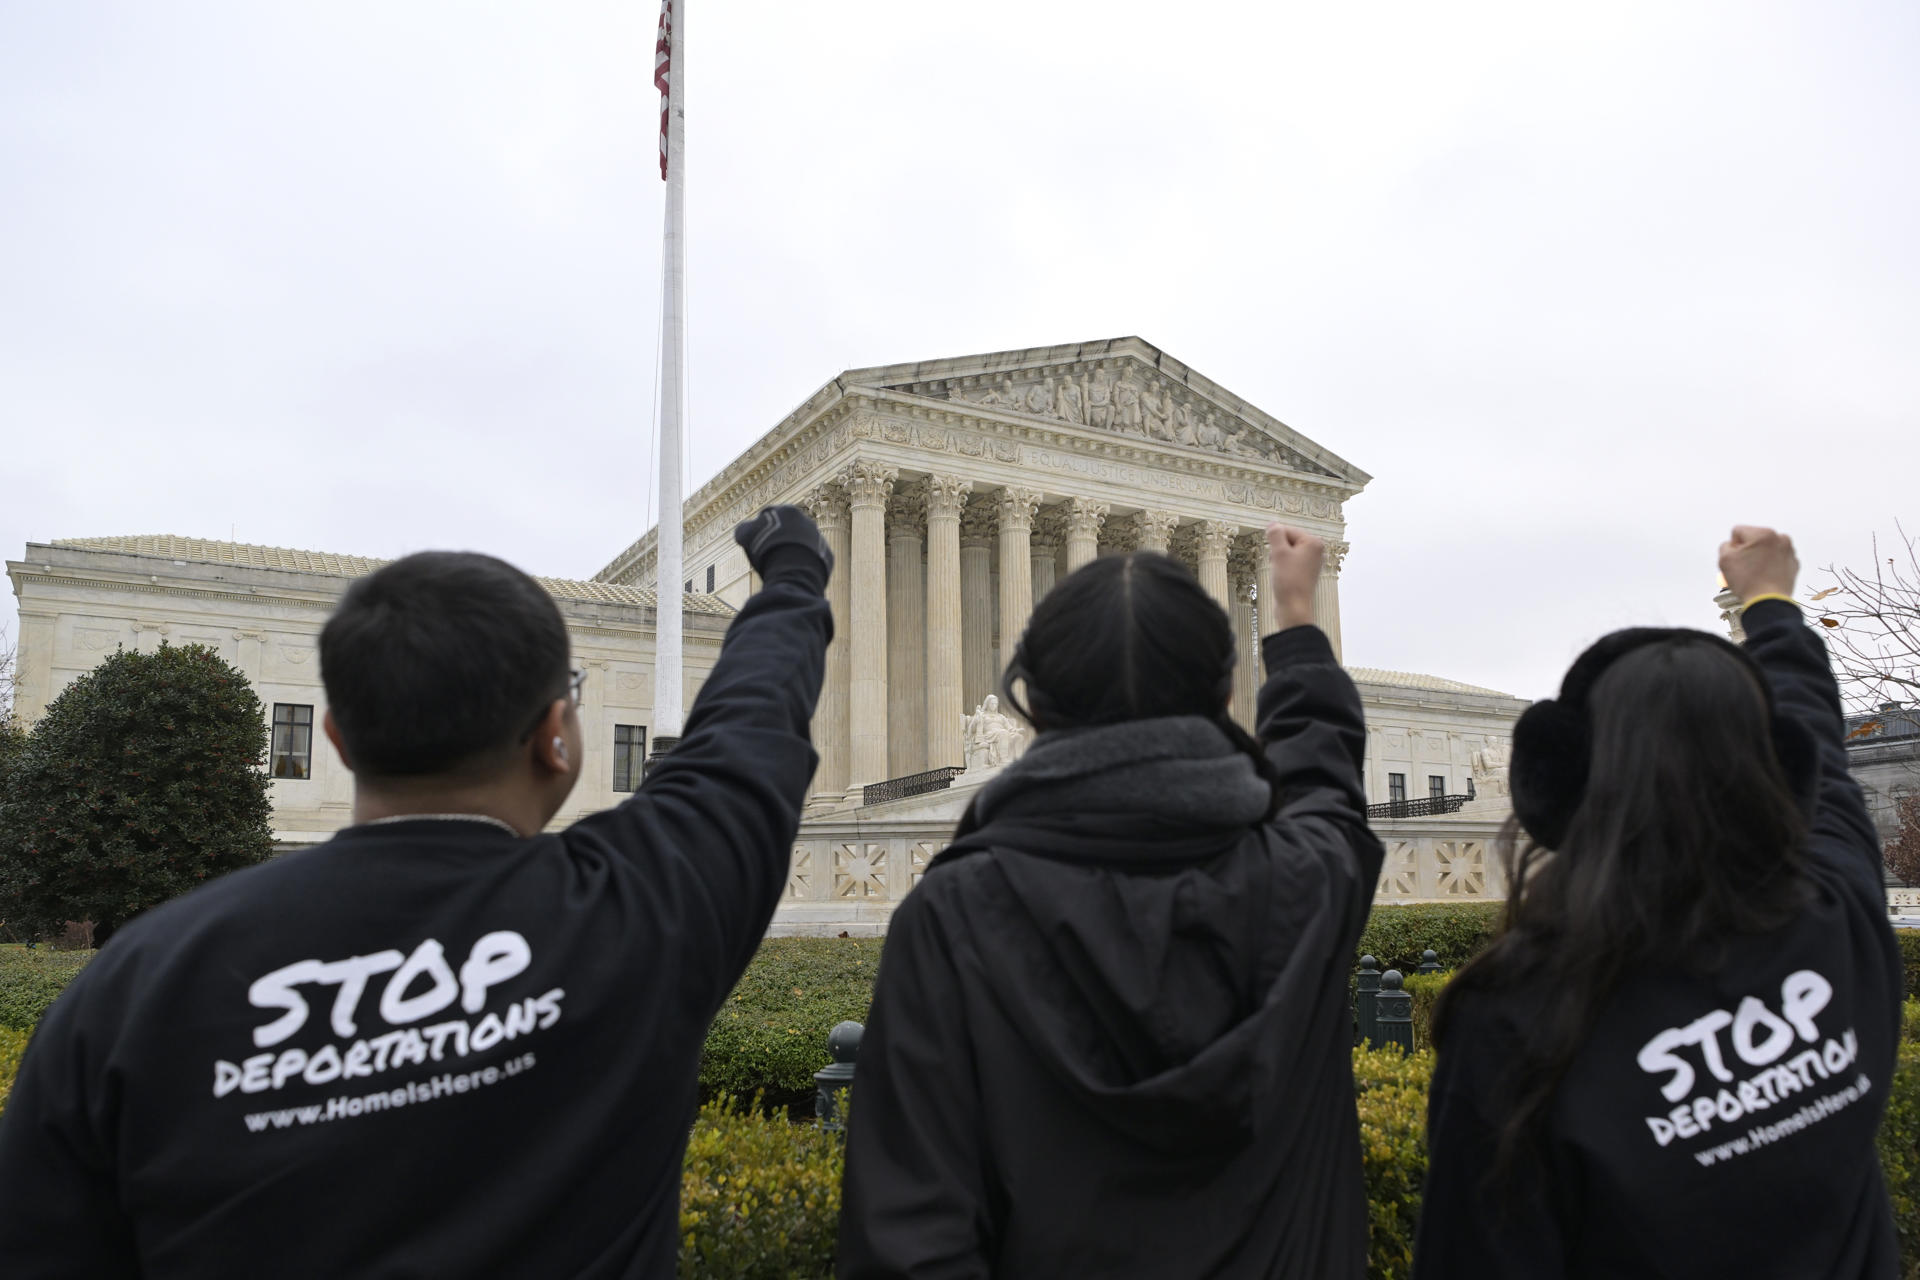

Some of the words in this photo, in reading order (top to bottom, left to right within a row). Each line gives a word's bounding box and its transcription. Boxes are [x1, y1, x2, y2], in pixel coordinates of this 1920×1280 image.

[212, 988, 565, 1098] DEPORTATIONS
[248, 930, 532, 1048] STOP
[1636, 969, 1833, 1103] STOP
[243, 1052, 537, 1132] www.HomeIsHere.us
